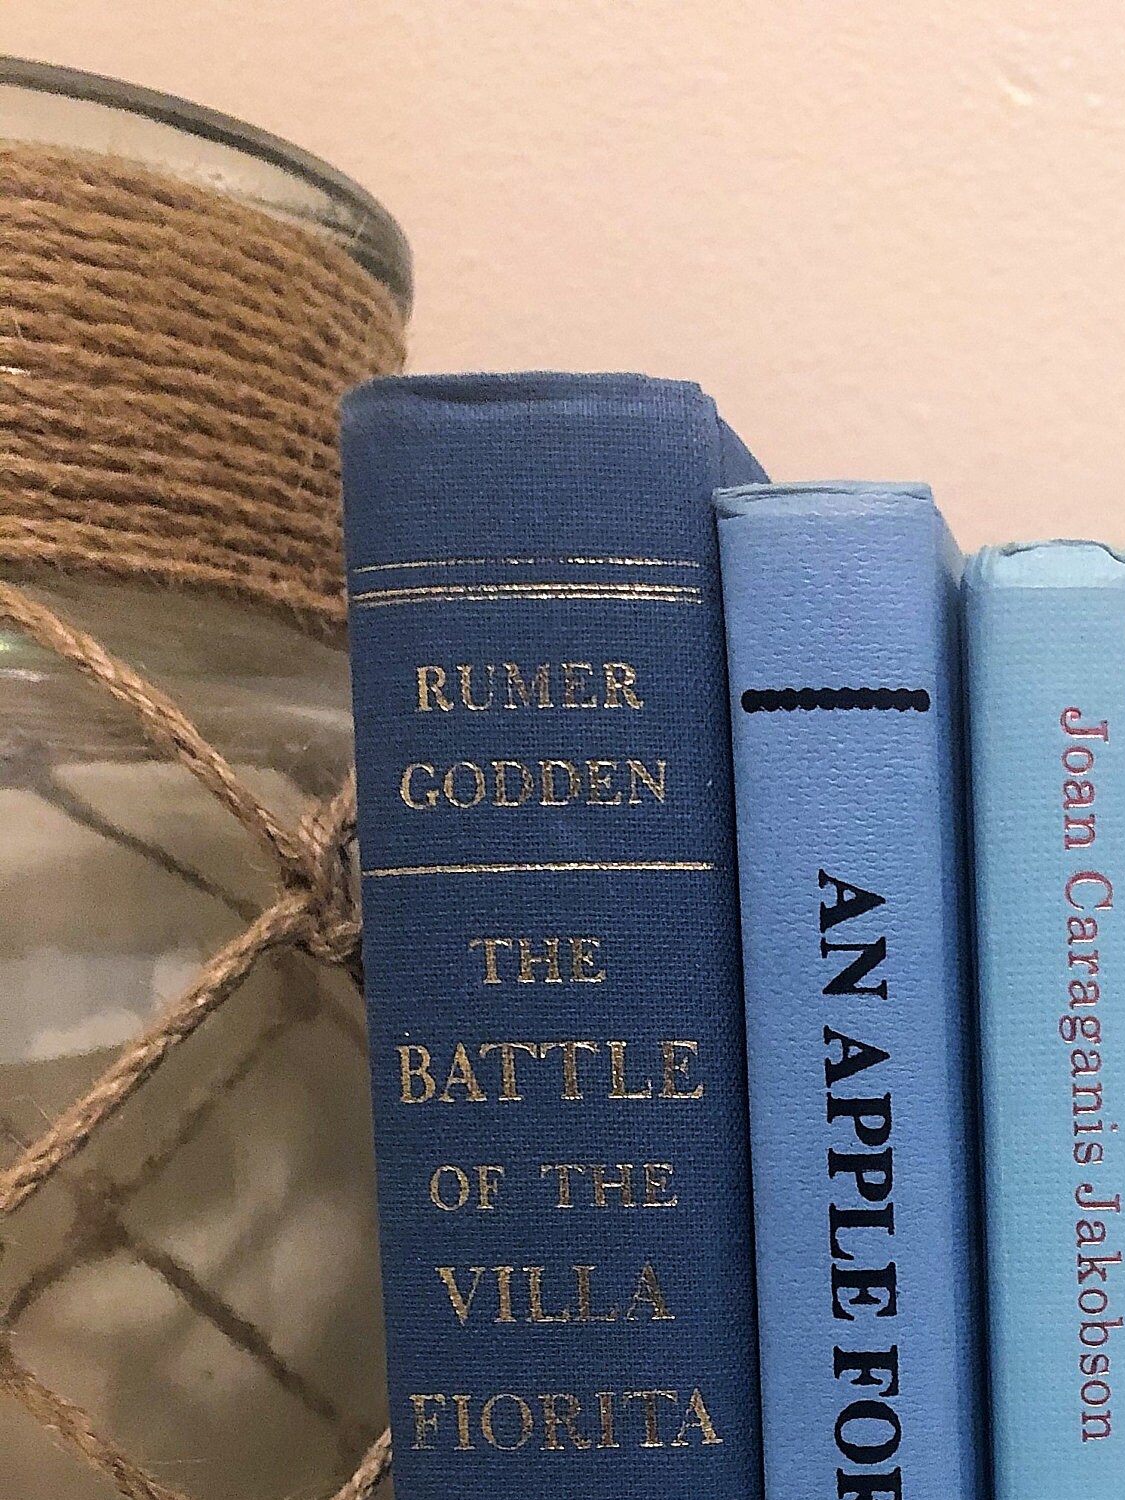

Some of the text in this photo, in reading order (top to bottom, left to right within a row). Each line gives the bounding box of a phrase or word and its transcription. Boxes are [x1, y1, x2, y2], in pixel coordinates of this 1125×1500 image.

[413, 661, 644, 712] RUMER
[400, 759, 667, 810] GODDEN
[469, 937, 607, 985] THE
[817, 867, 888, 1001] AN
[397, 1039, 704, 1104] BATTLE
[1058, 705, 1125, 1444] Joan Caraganis Jakobson
[429, 1162, 678, 1212] OF THE
[822, 1024, 898, 1321] APPLE
[435, 1260, 676, 1326] VILLA
[408, 1387, 723, 1451] FIORITA
